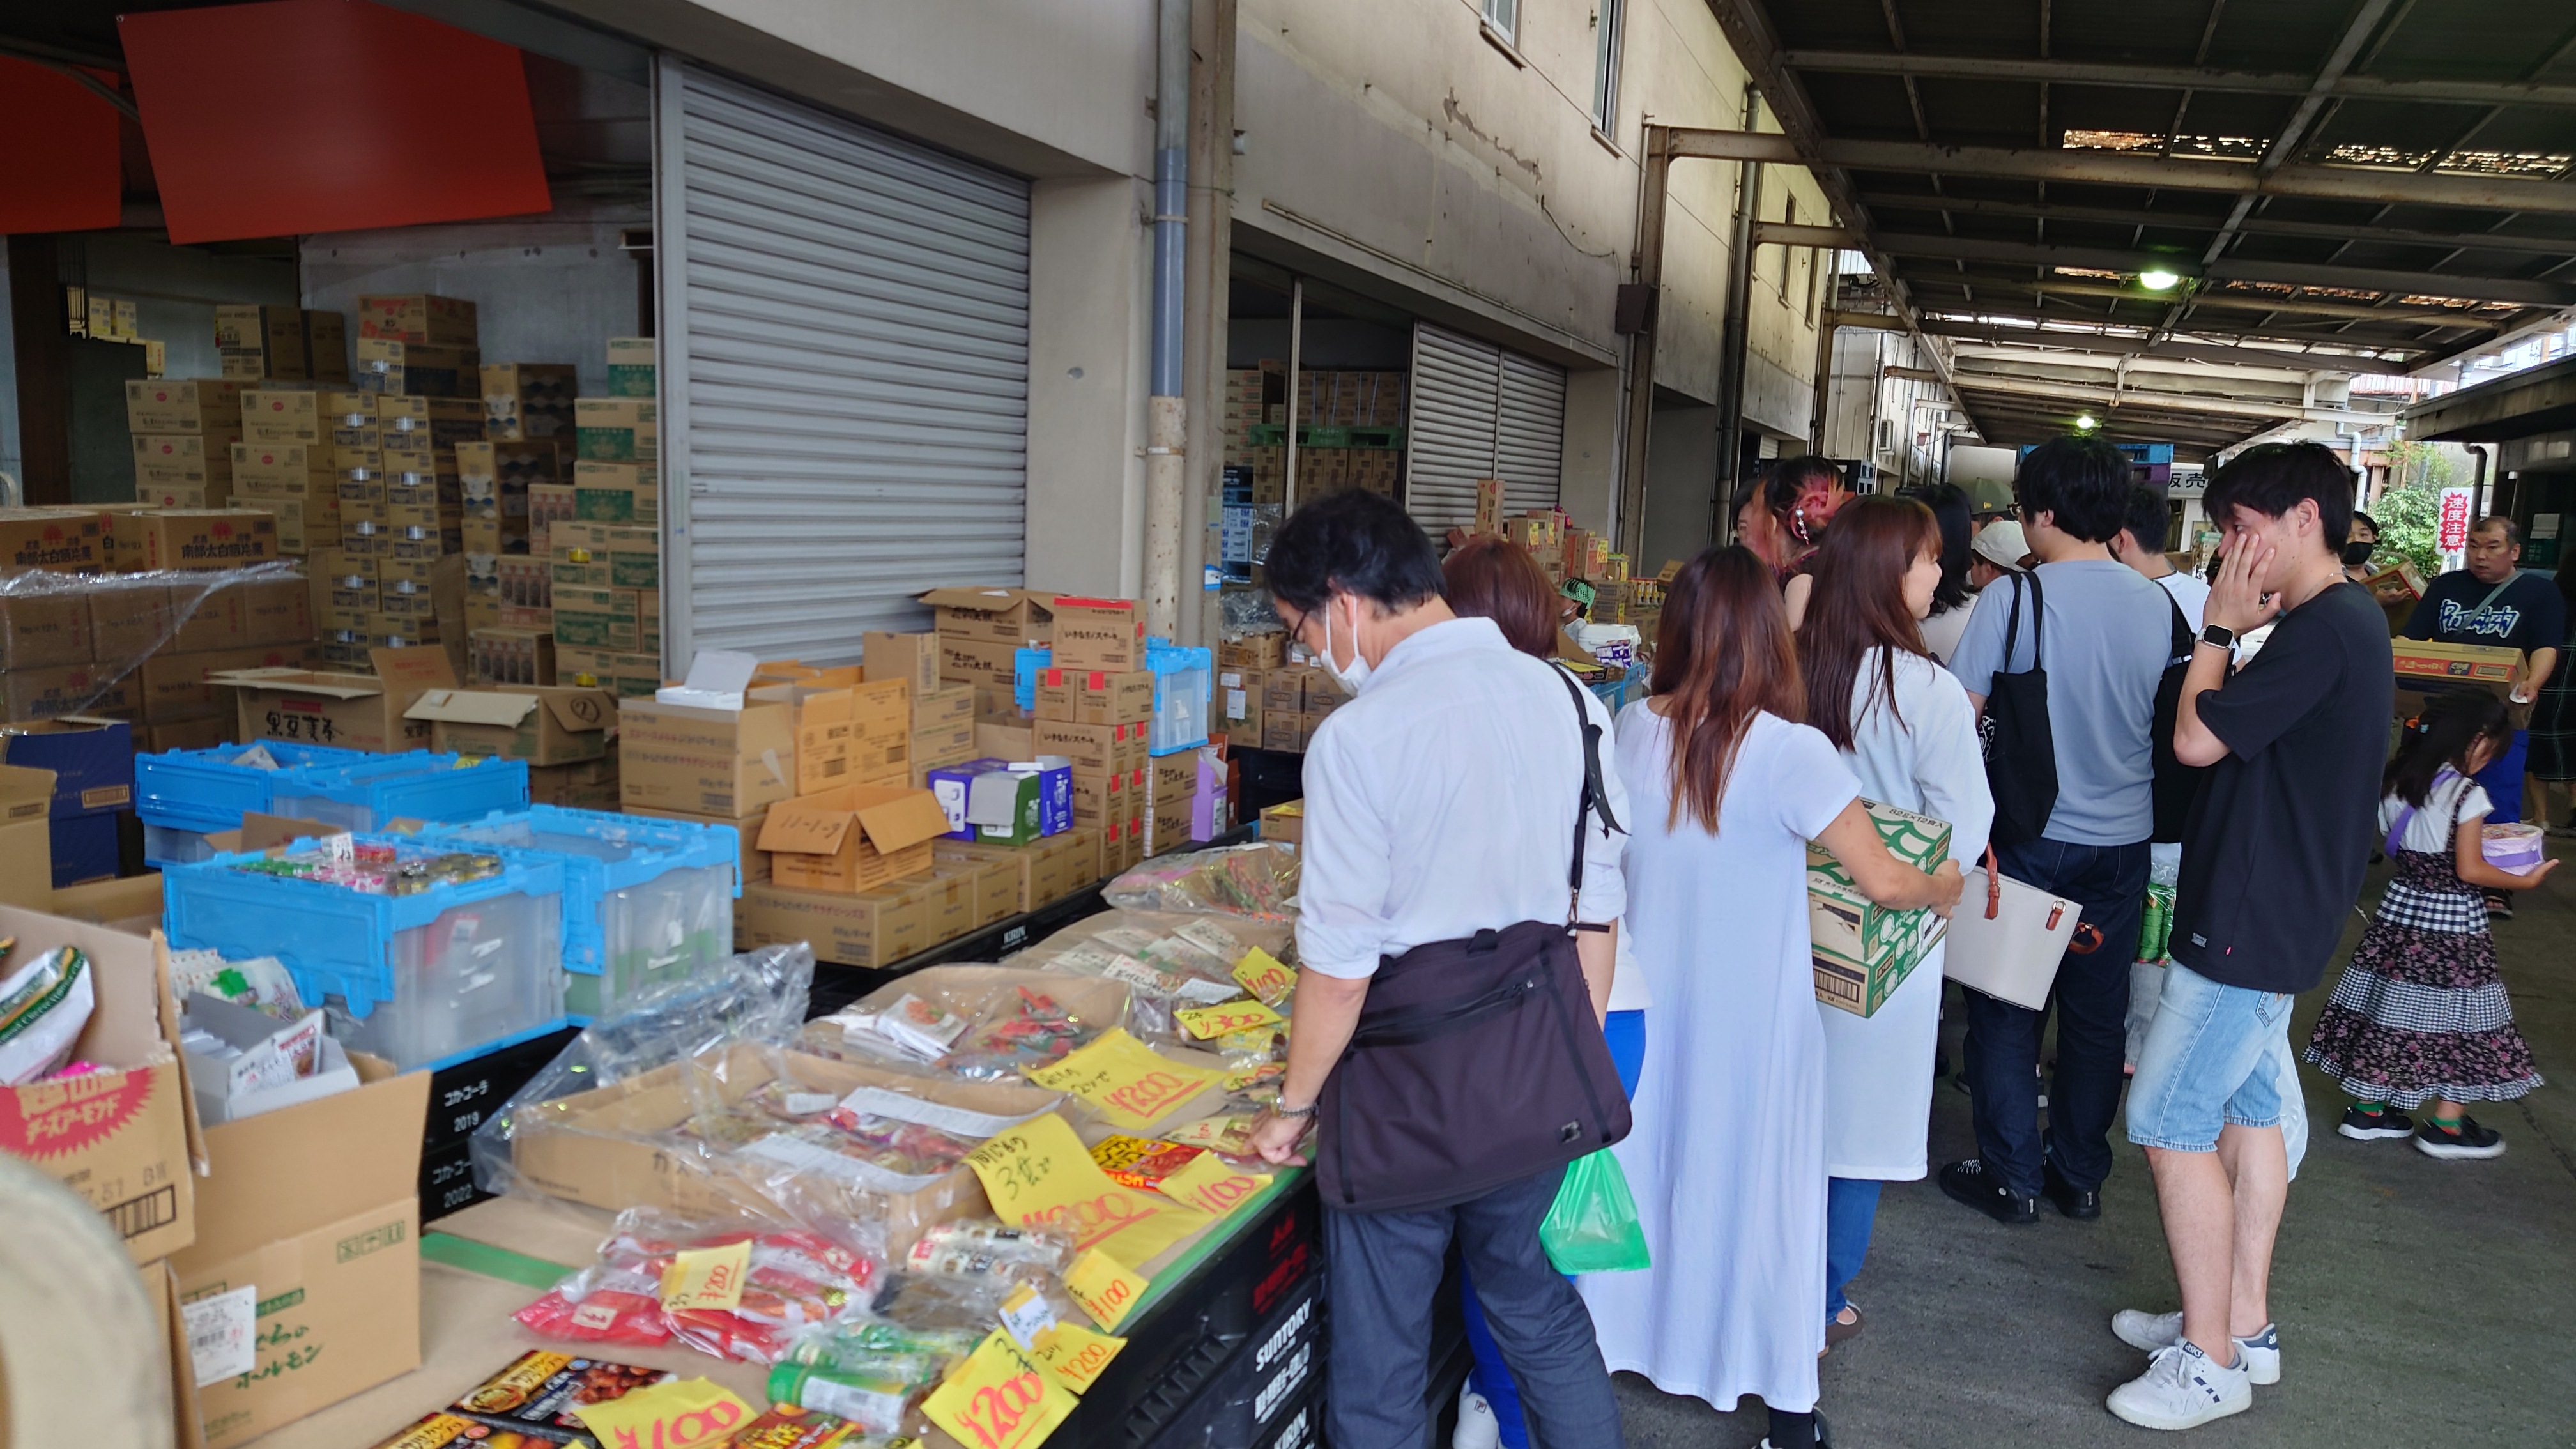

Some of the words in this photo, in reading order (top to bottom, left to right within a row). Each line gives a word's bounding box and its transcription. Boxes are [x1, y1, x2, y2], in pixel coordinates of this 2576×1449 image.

[2444, 497, 2464, 546] 速度注意
[454, 1110, 479, 1133] 2019
[443, 1183, 473, 1209] 2022
[1087, 1278, 1130, 1323] ¥100
[1255, 1296, 1312, 1372] SUNTORY
[2184, 1344, 2202, 1358] asics
[1055, 1342, 1107, 1382] ¥200
[954, 1370, 1044, 1449] ¥200
